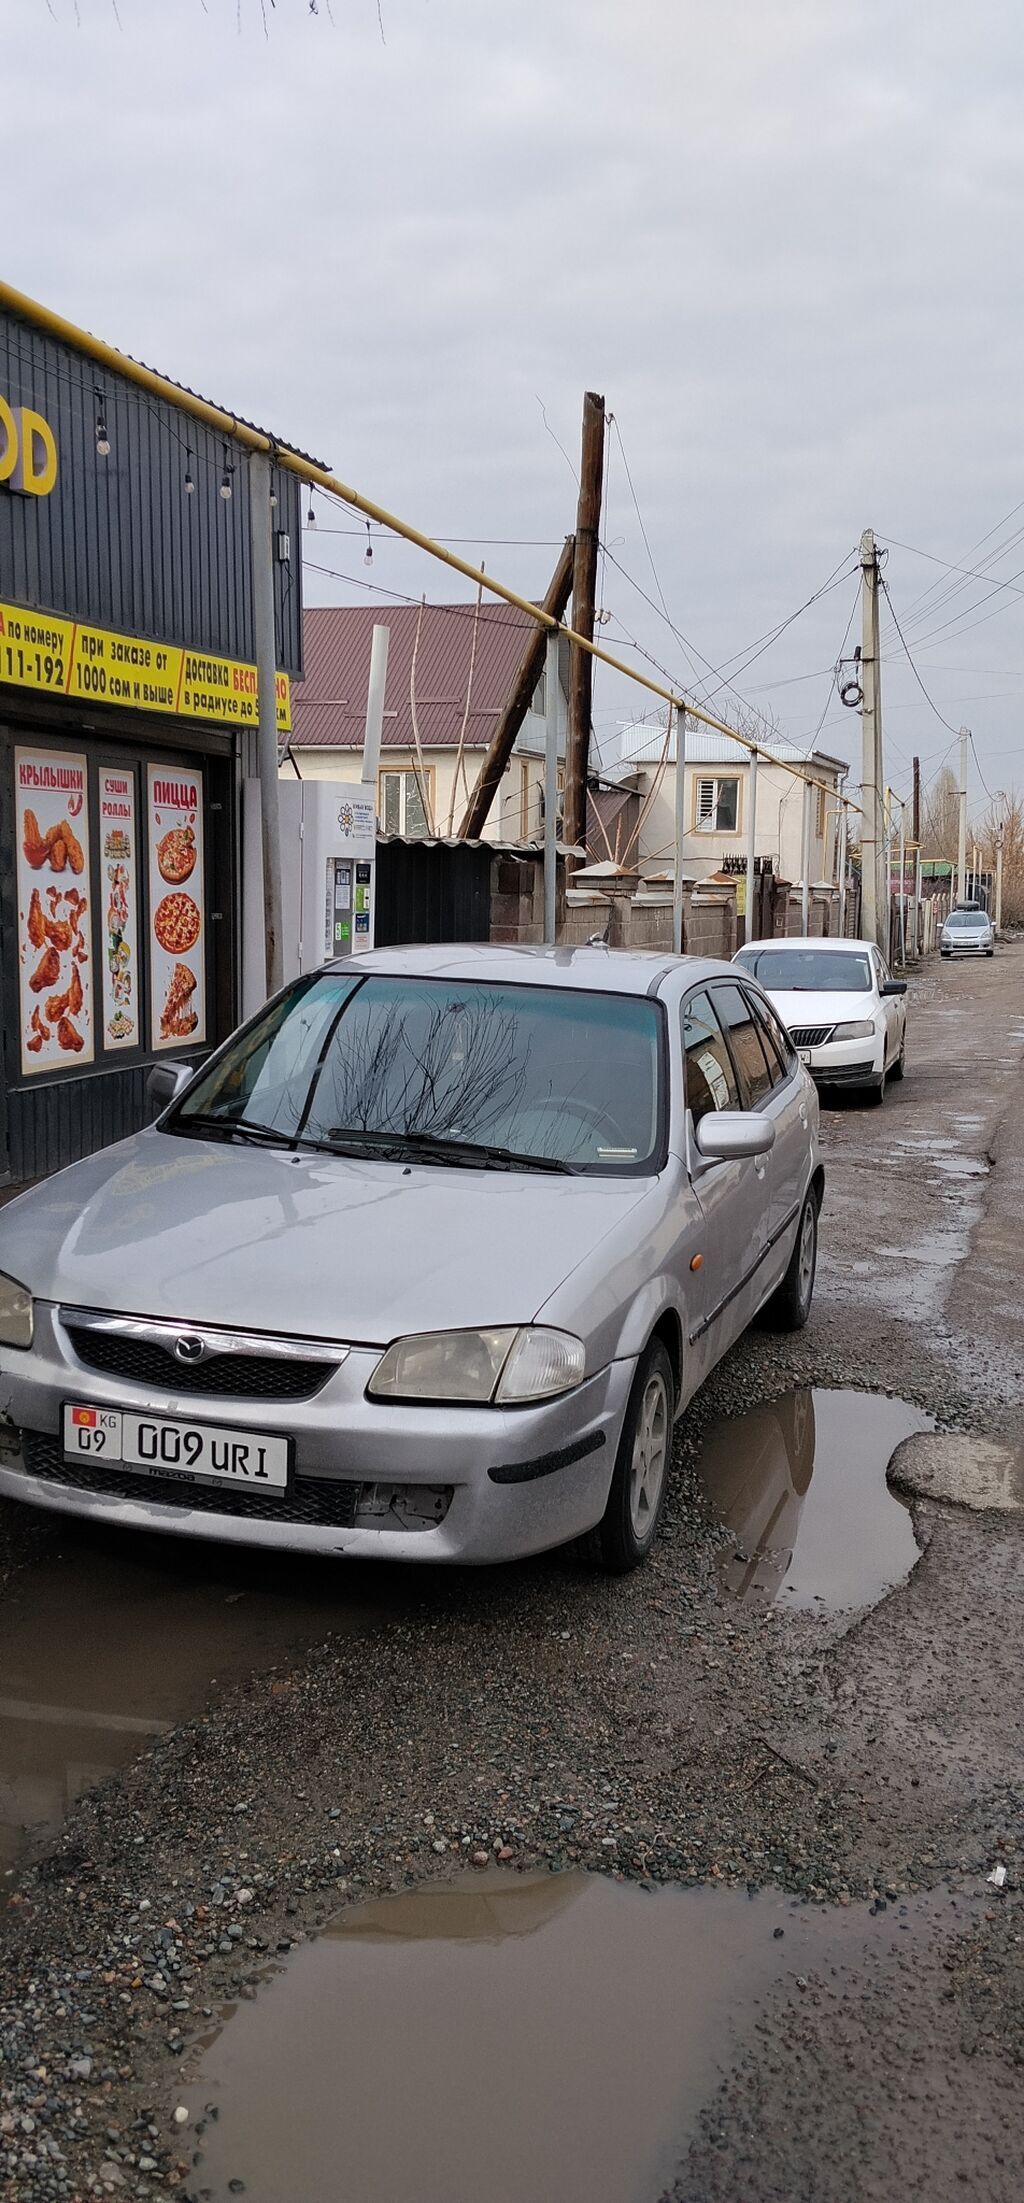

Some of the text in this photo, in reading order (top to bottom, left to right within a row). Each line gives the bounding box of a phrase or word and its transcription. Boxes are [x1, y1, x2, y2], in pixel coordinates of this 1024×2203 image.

[8, 621, 21, 640] по
[24, 625, 64, 656] номеру
[0, 645, 64, 686] 11-192
[82, 635, 167, 670] при заказе от
[77, 663, 173, 705] 1000 сом и выше
[186, 657, 287, 700] доставка БЕСПНО
[184, 691, 190, 705] в
[193, 693, 238, 715] радиусе
[241, 702, 253, 718] до
[19, 764, 84, 790] КРЫЛЫШКИ
[105, 779, 128, 794] СУШИ
[153, 781, 197, 808] ПИЦЦА
[102, 802, 131, 817] РОЛЛЫ
[100, 1415, 117, 1428] KG
[78, 1428, 106, 1451] 09
[138, 1424, 268, 1478] 009 URI
[149, 1467, 196, 1481] mazda
